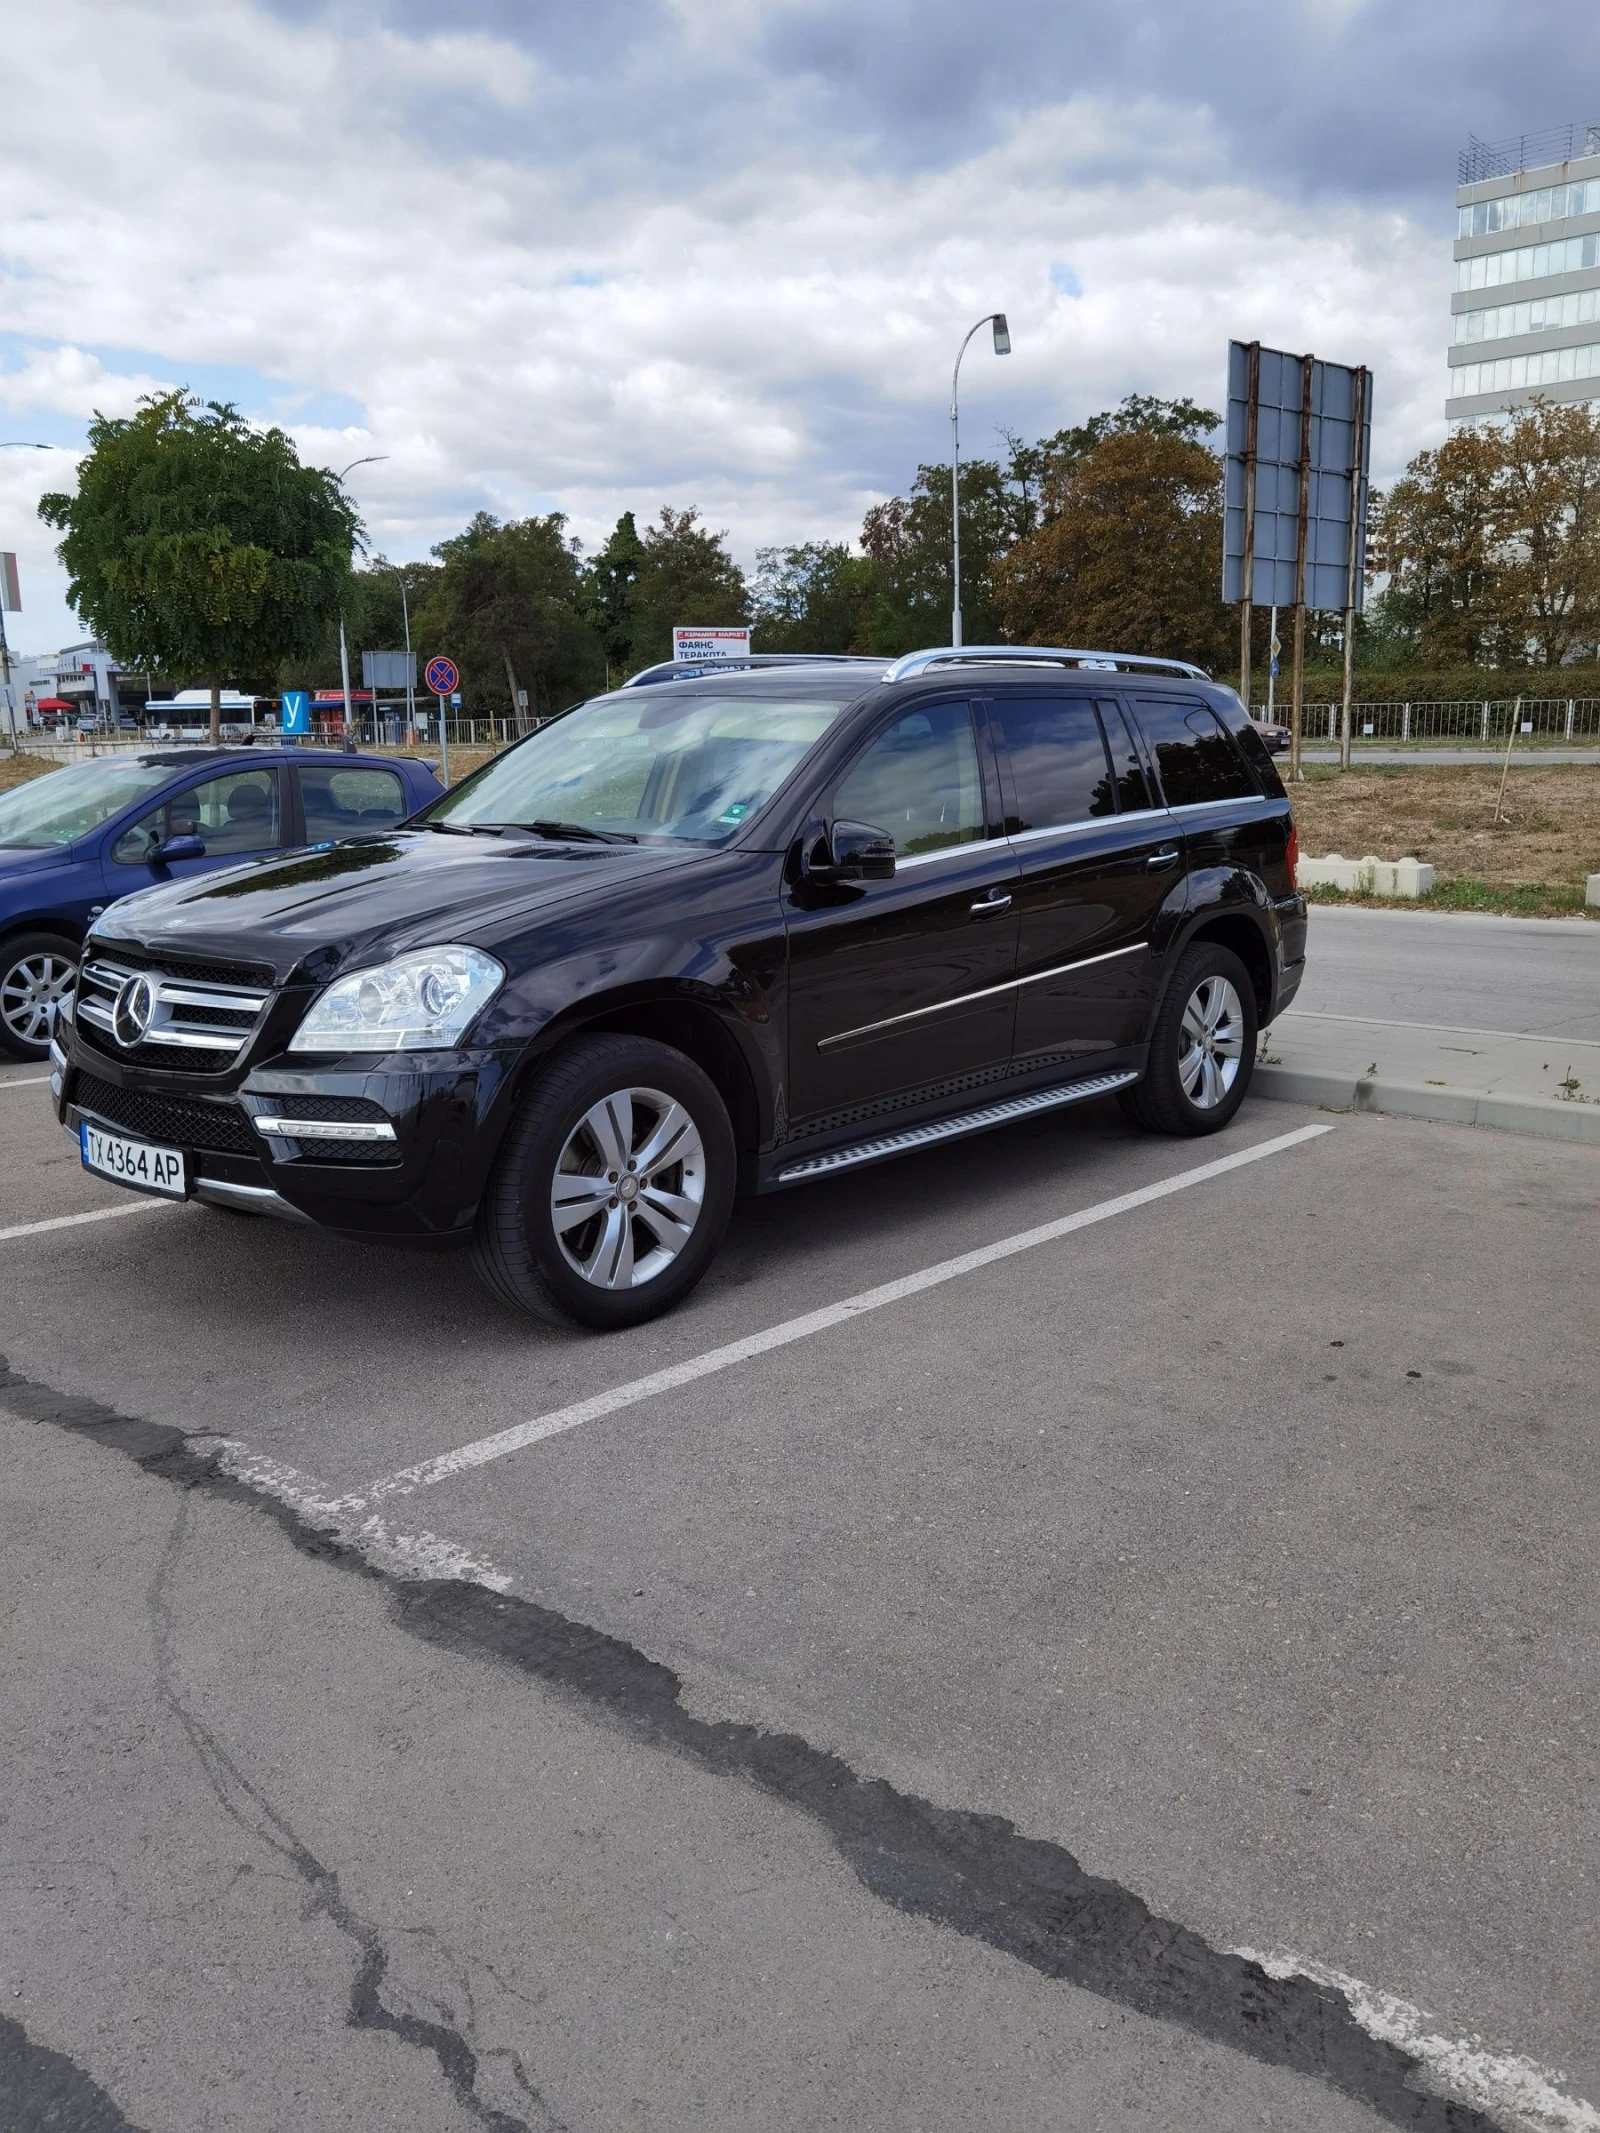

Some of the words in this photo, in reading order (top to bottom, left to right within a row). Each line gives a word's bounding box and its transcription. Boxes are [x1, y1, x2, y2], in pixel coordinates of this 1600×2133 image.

[679, 641, 714, 649] ФАЯНС
[679, 651, 727, 659] ТЕРАКОТА
[106, 1140, 149, 1180] 4364
